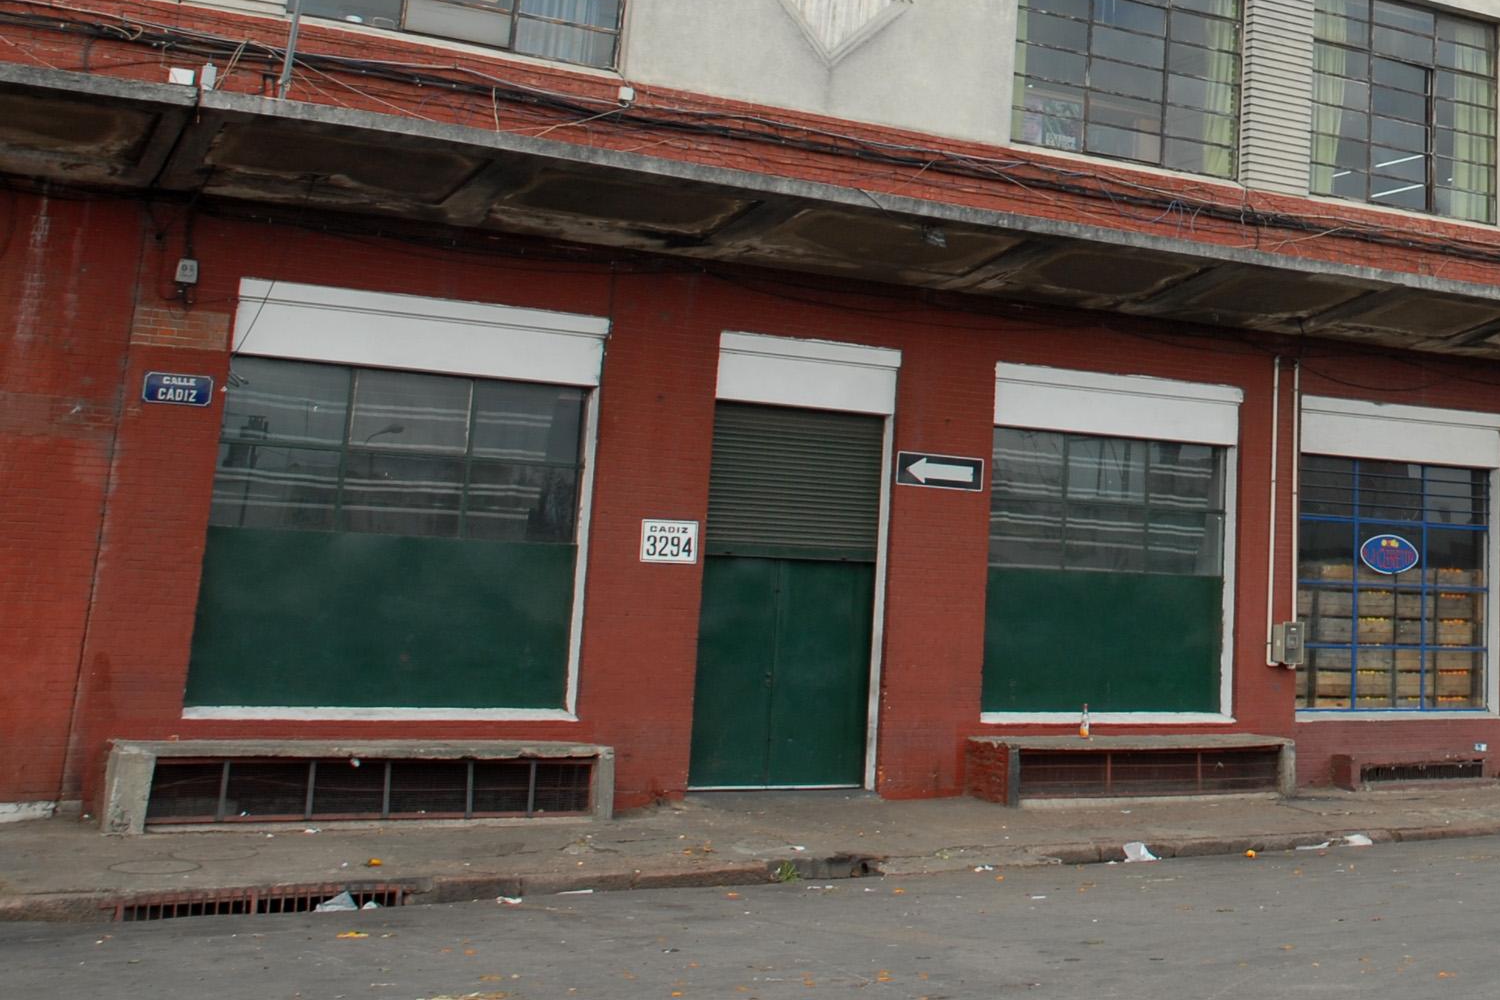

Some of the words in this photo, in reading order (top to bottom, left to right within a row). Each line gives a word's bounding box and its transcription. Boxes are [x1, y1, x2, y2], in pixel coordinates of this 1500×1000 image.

[162, 376, 197, 386] CALLE
[650, 525, 689, 534] CADIZ
[646, 535, 692, 557] 3294
